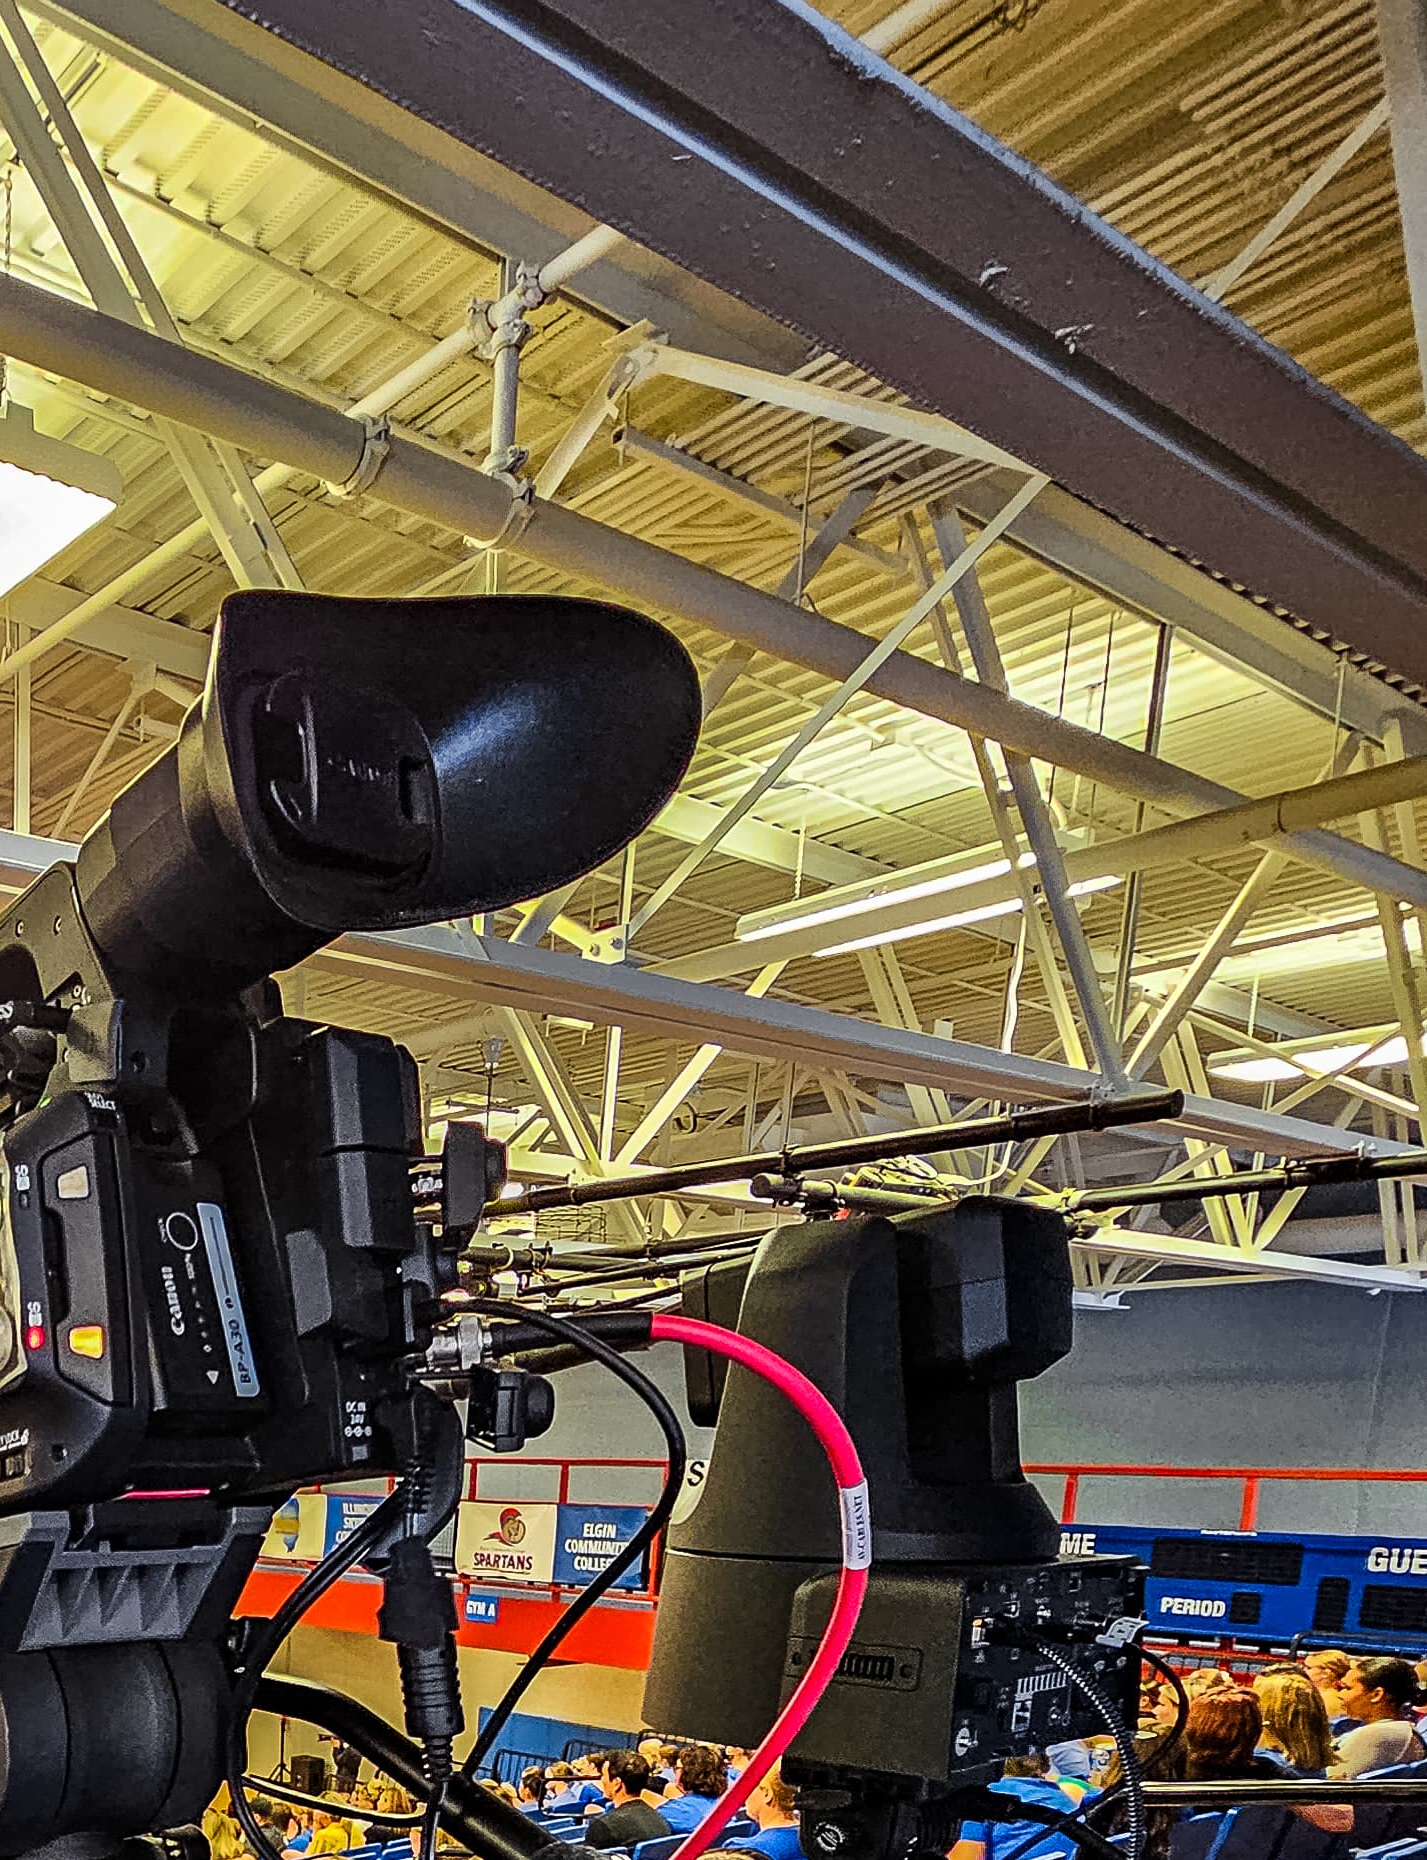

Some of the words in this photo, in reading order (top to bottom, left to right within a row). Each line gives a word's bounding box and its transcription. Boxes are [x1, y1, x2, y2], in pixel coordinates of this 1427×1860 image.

[228, 1319, 252, 1384] BP-A30
[583, 1522, 617, 1539] ELGIN
[1060, 1532, 1097, 1556] ME
[473, 1551, 533, 1571] SPARTANS
[1366, 1547, 1427, 1574] GUE
[465, 1600, 485, 1615] GYM
[487, 1602, 496, 1617] A
[1160, 1596, 1226, 1618] PERIOD
